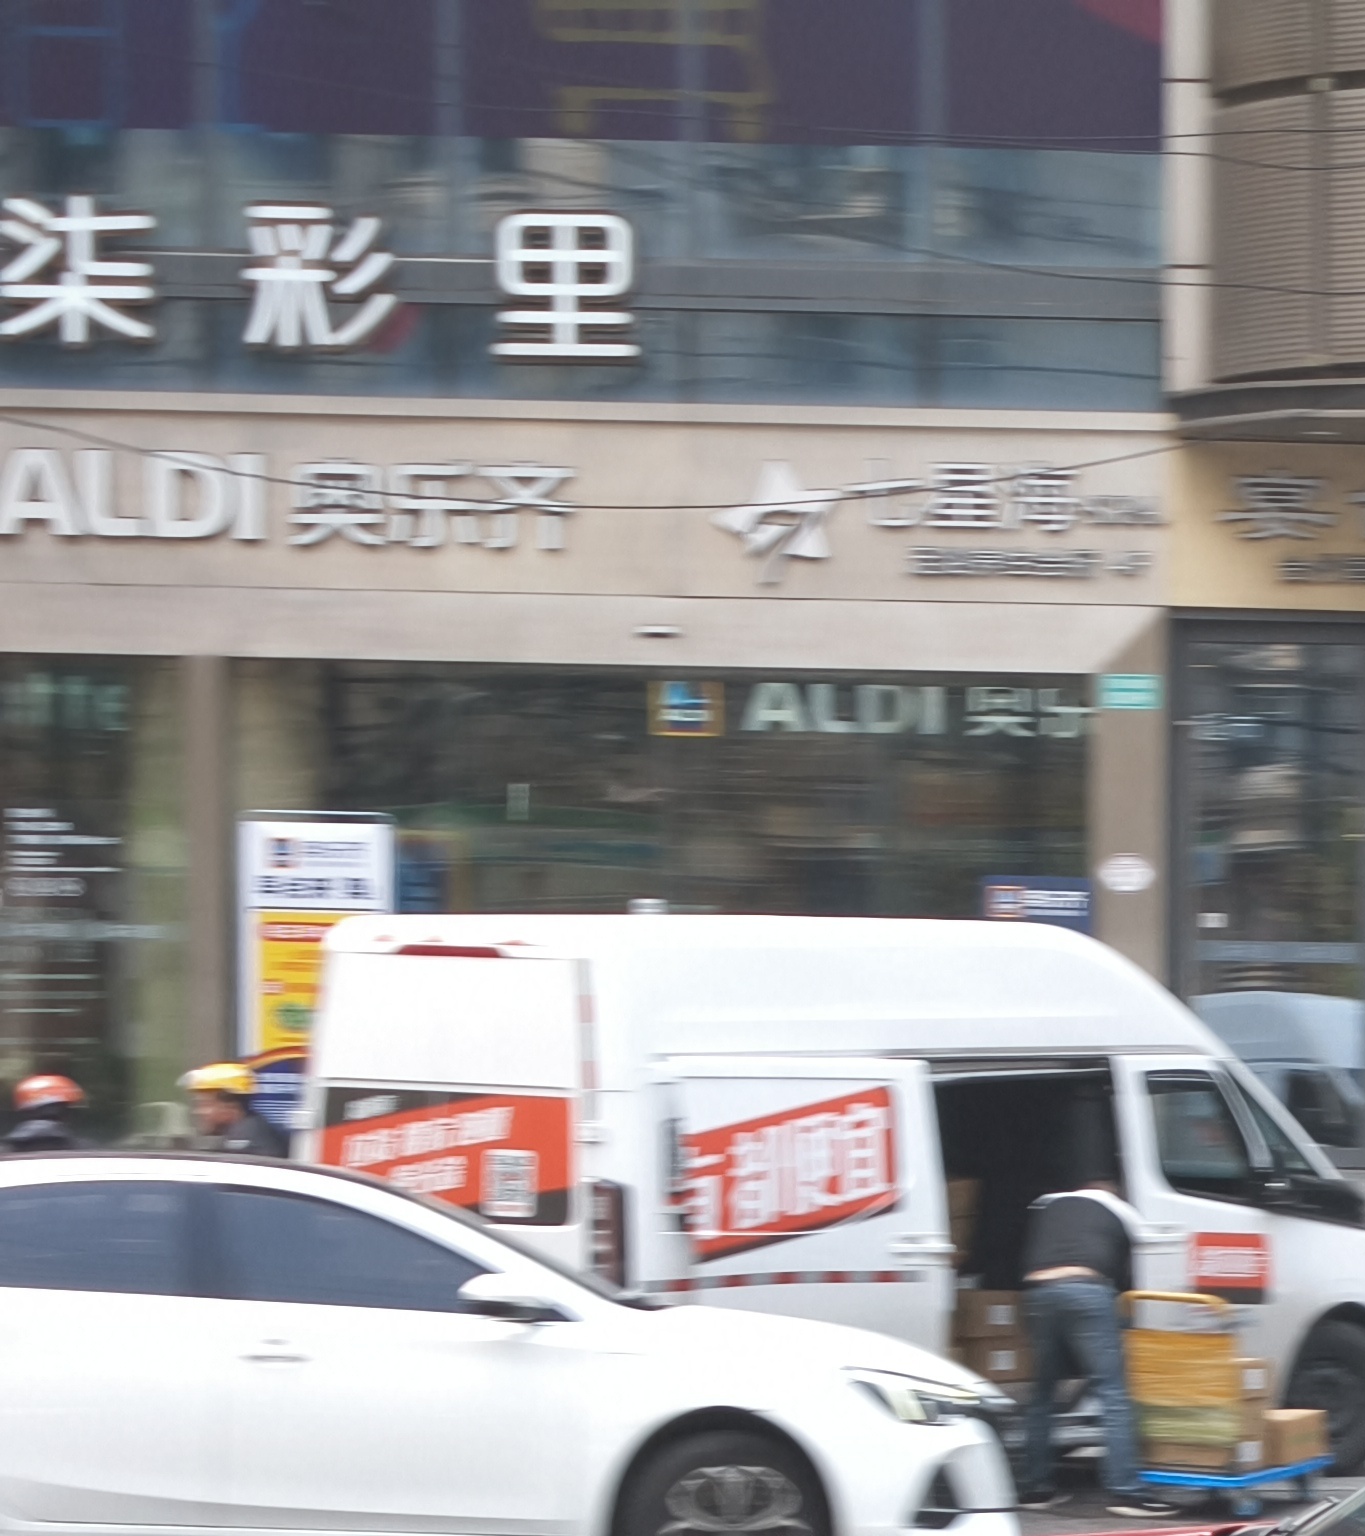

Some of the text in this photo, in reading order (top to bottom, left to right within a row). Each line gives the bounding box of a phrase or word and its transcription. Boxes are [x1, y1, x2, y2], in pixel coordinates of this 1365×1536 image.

[0, 194, 642, 357] 柒彩里
[0, 447, 578, 550] ALDI 奥乐齐
[738, 681, 946, 736] ALDI
